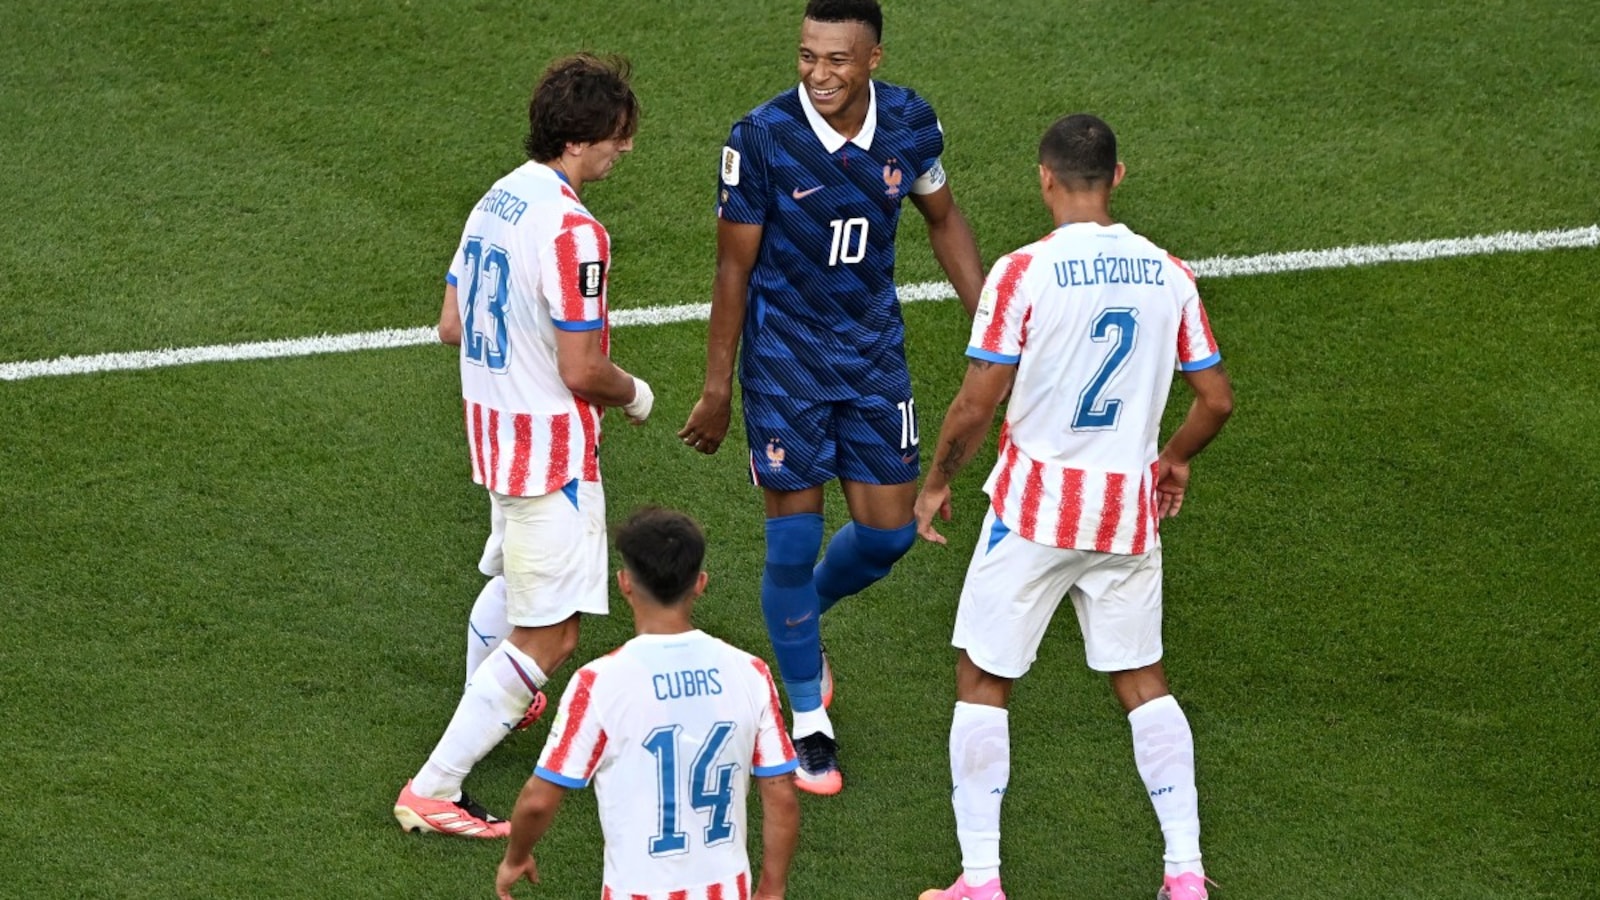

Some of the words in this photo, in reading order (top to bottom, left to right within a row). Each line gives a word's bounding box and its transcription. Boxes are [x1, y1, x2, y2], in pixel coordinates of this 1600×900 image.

[828, 217, 870, 266] 10
[1053, 252, 1165, 288] VELÁZQUEZ
[463, 235, 513, 375] 23
[1071, 306, 1140, 433] 2
[652, 667, 723, 701] CUBAS
[641, 720, 741, 858] 14
